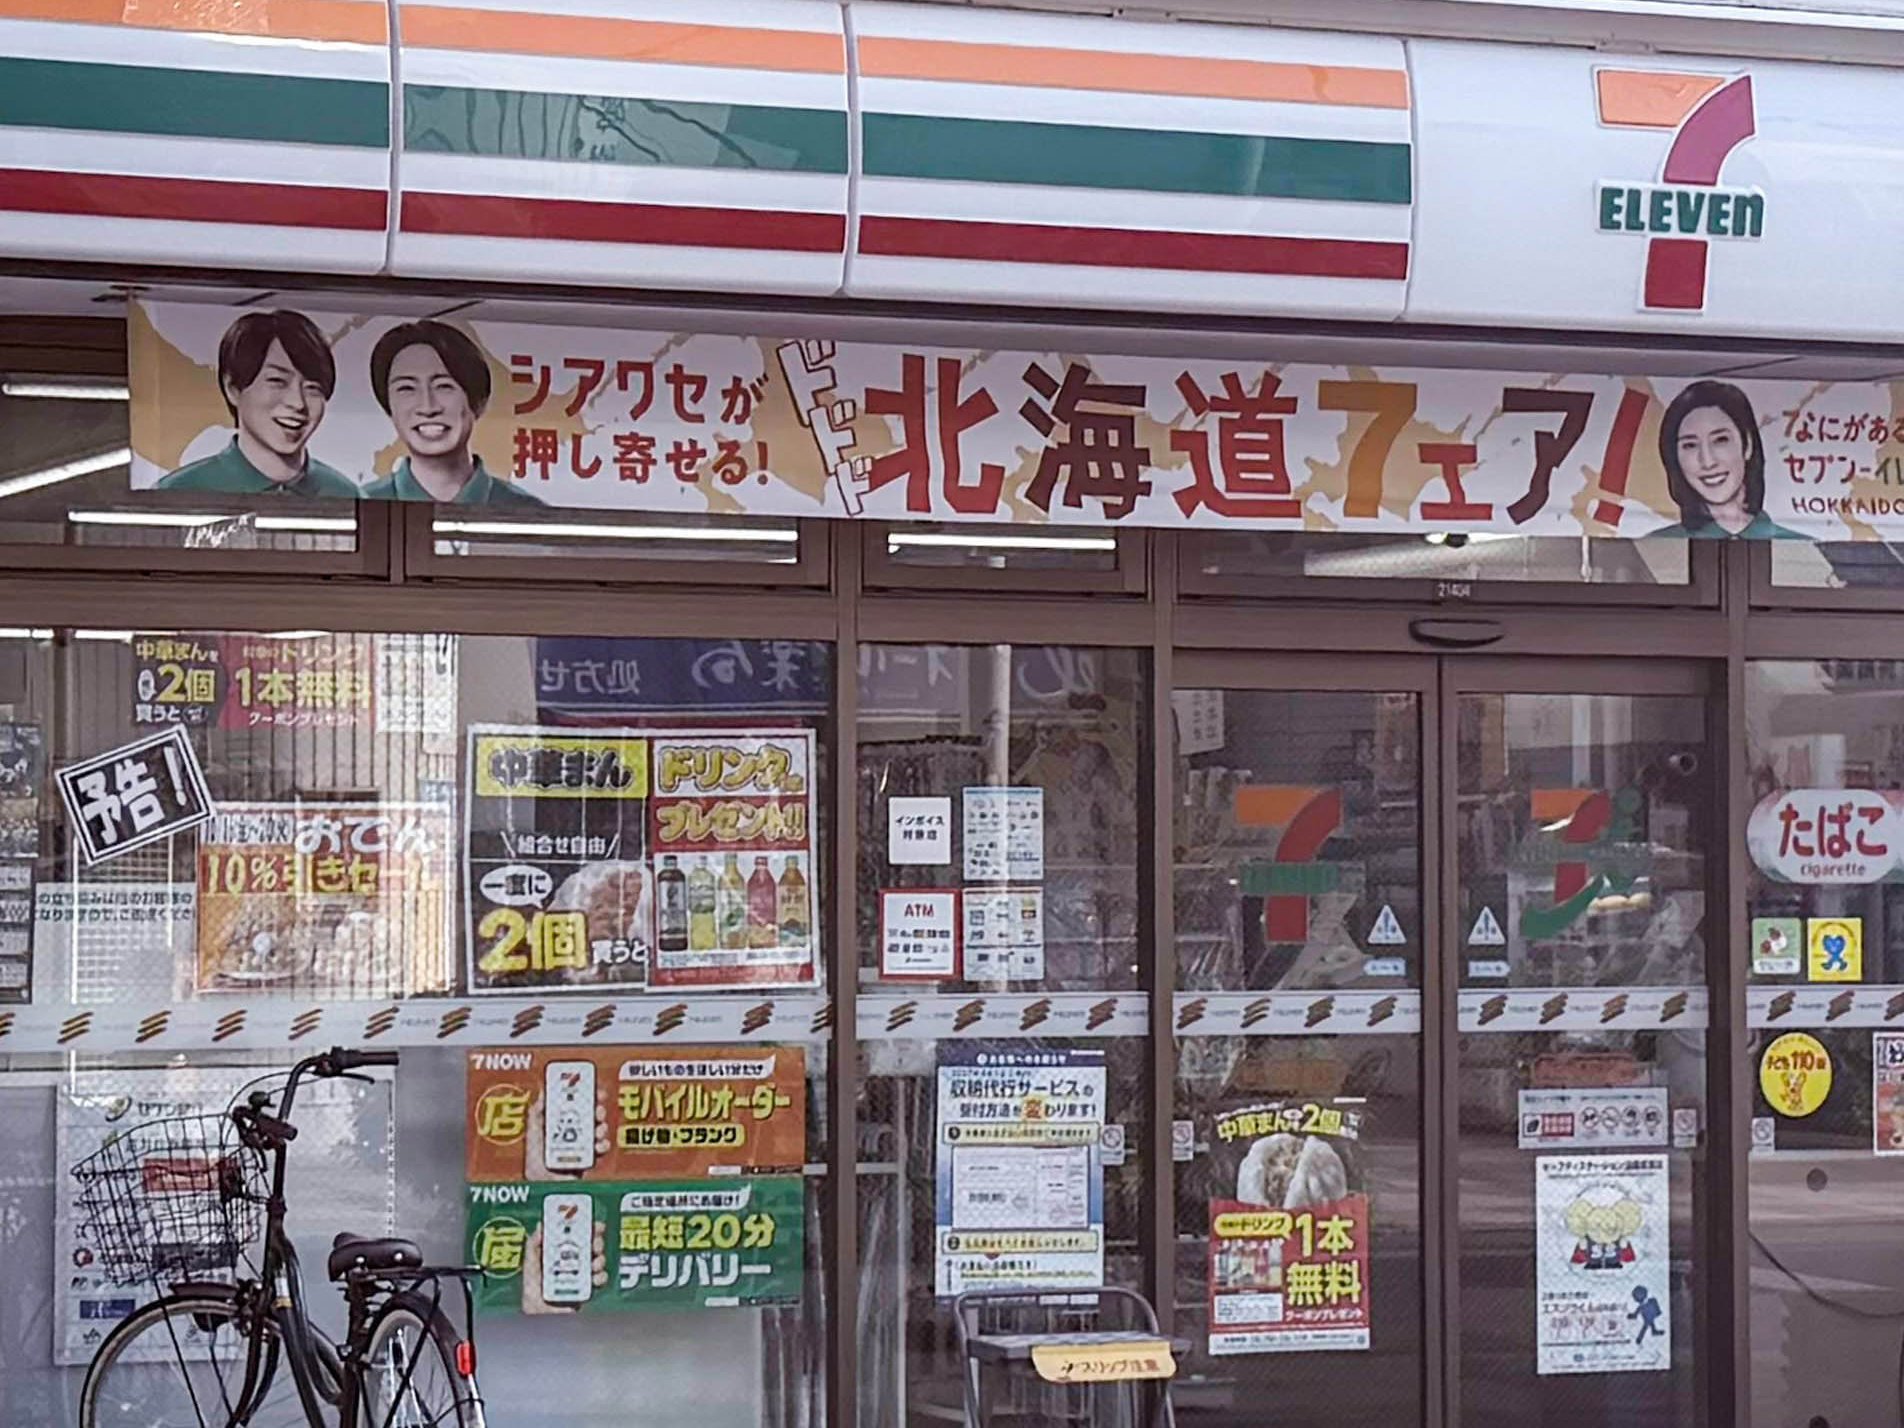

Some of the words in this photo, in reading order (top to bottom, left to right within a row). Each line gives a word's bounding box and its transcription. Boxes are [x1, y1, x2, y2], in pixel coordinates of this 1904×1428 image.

[509, 354, 771, 427] シアワセが
[512, 428, 770, 486] 押し寄せる!
[156, 663, 216, 704] 2個
[235, 667, 372, 709] 1本無料
[487, 745, 634, 790] 中華まん
[295, 815, 437, 856] おでん
[1778, 802, 1888, 859] たばこ
[904, 903, 935, 918] ATM
[478, 908, 588, 972] 2個
[591, 939, 650, 965] 買うと
[476, 1090, 532, 1137] 店
[617, 1082, 792, 1121] モバイルオーダー
[469, 1186, 531, 1203] 7NOW
[618, 1213, 776, 1251] 最短20分
[1294, 1212, 1355, 1258] 1本
[619, 1253, 773, 1289] デリバリー
[1286, 1259, 1362, 1306] 無料
